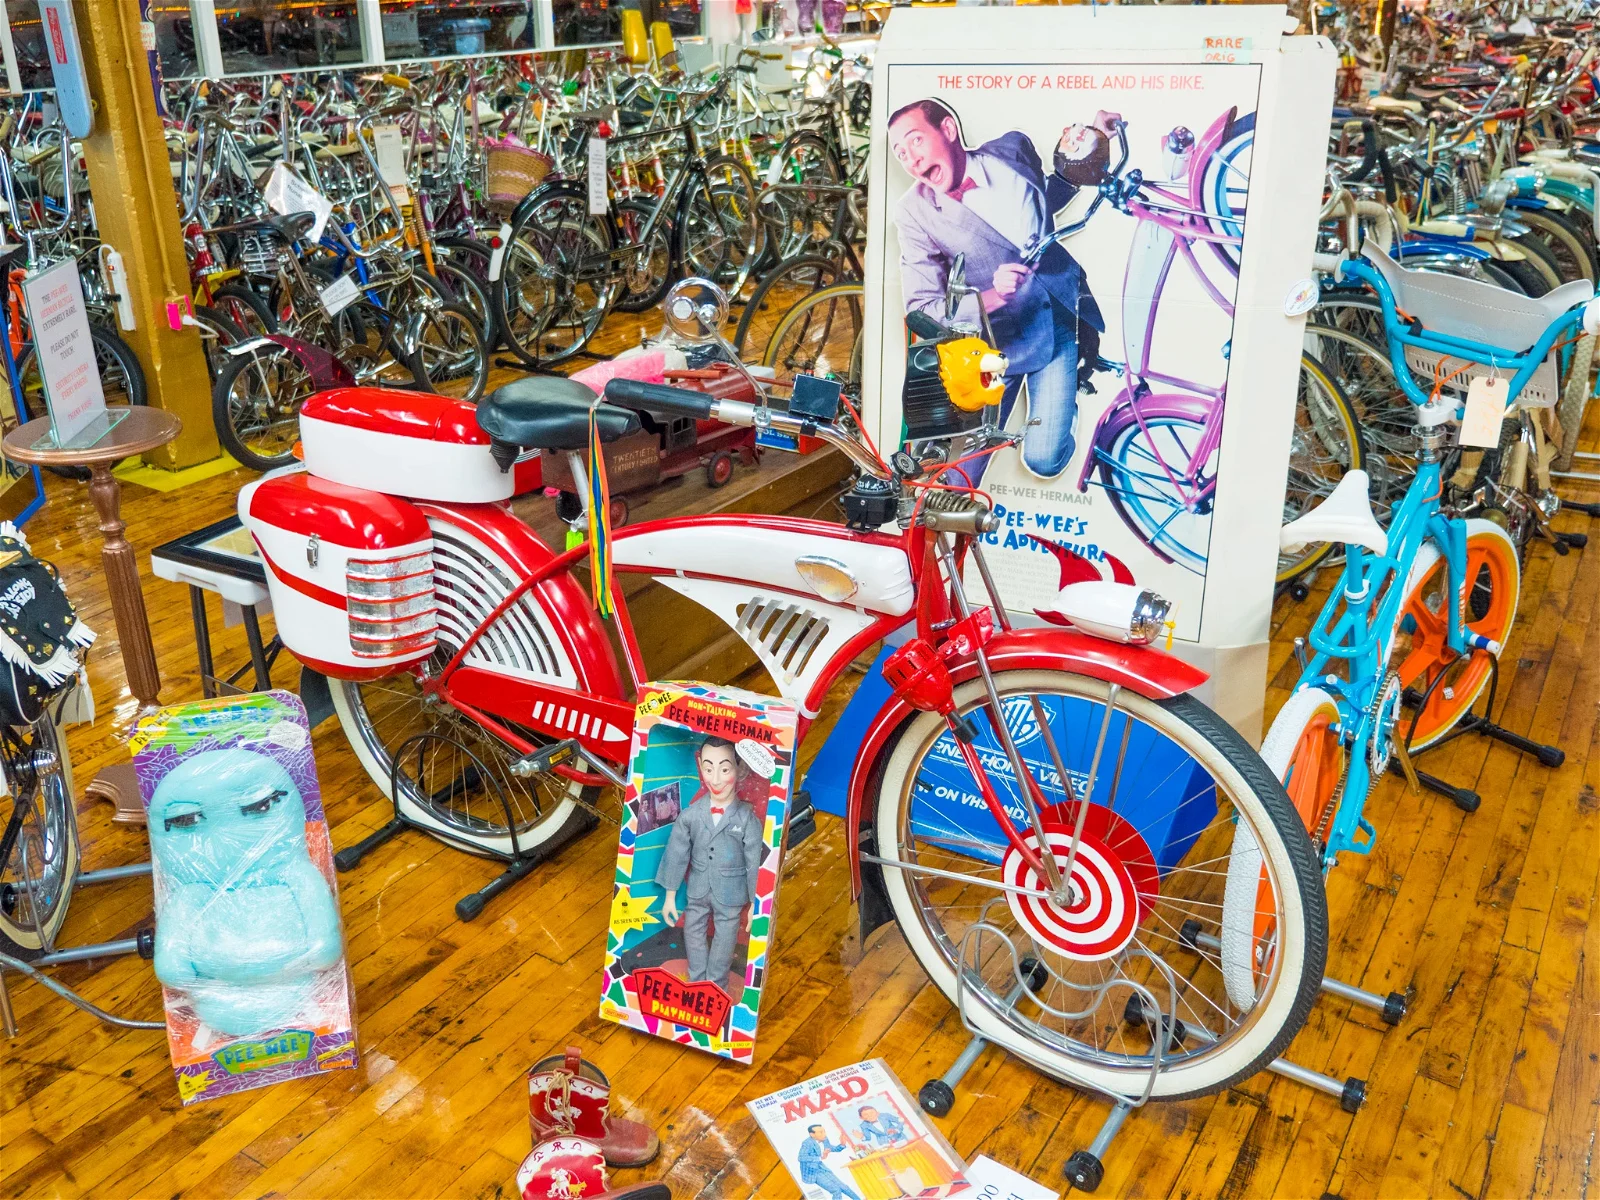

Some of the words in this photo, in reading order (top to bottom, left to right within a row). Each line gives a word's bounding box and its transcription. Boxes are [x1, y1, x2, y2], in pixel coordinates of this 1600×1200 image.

[1204, 37, 1245, 49] RARE
[937, 75, 963, 90] THE
[966, 75, 1012, 90] STORY
[1017, 75, 1038, 90] OF
[1041, 75, 1053, 90] A
[1056, 75, 1098, 90] REBEL
[1101, 75, 1137, 90] AND
[1140, 75, 1165, 90] HIS
[1170, 75, 1205, 90] BIKE.
[41, 293, 51, 304] THE
[42, 311, 66, 332] EXTREMELY
[50, 337, 66, 354] PLEASE
[70, 329, 80, 339] NOT
[989, 483, 1037, 499] PEE-WEE
[1039, 489, 1093, 506] HERMAN
[993, 503, 1089, 536] PEE-WEE'S
[639, 703, 652, 715] PEE
[657, 692, 672, 705] WEE
[687, 699, 737, 719] NON-TALKING
[669, 704, 719, 732] PEE-WEE
[723, 718, 773, 742] HERMAN
[1040, 764, 1095, 793] VIDEO
[934, 785, 959, 802] ON
[961, 792, 988, 810] VHS
[836, 1067, 854, 1076] MARTIN
[777, 1085, 804, 1097] CROCODILE
[780, 1075, 870, 1124] MAD
[783, 1091, 803, 1100] DUNDEE
[755, 1098, 764, 1106] PEE
[756, 1100, 778, 1110] HERMAN
